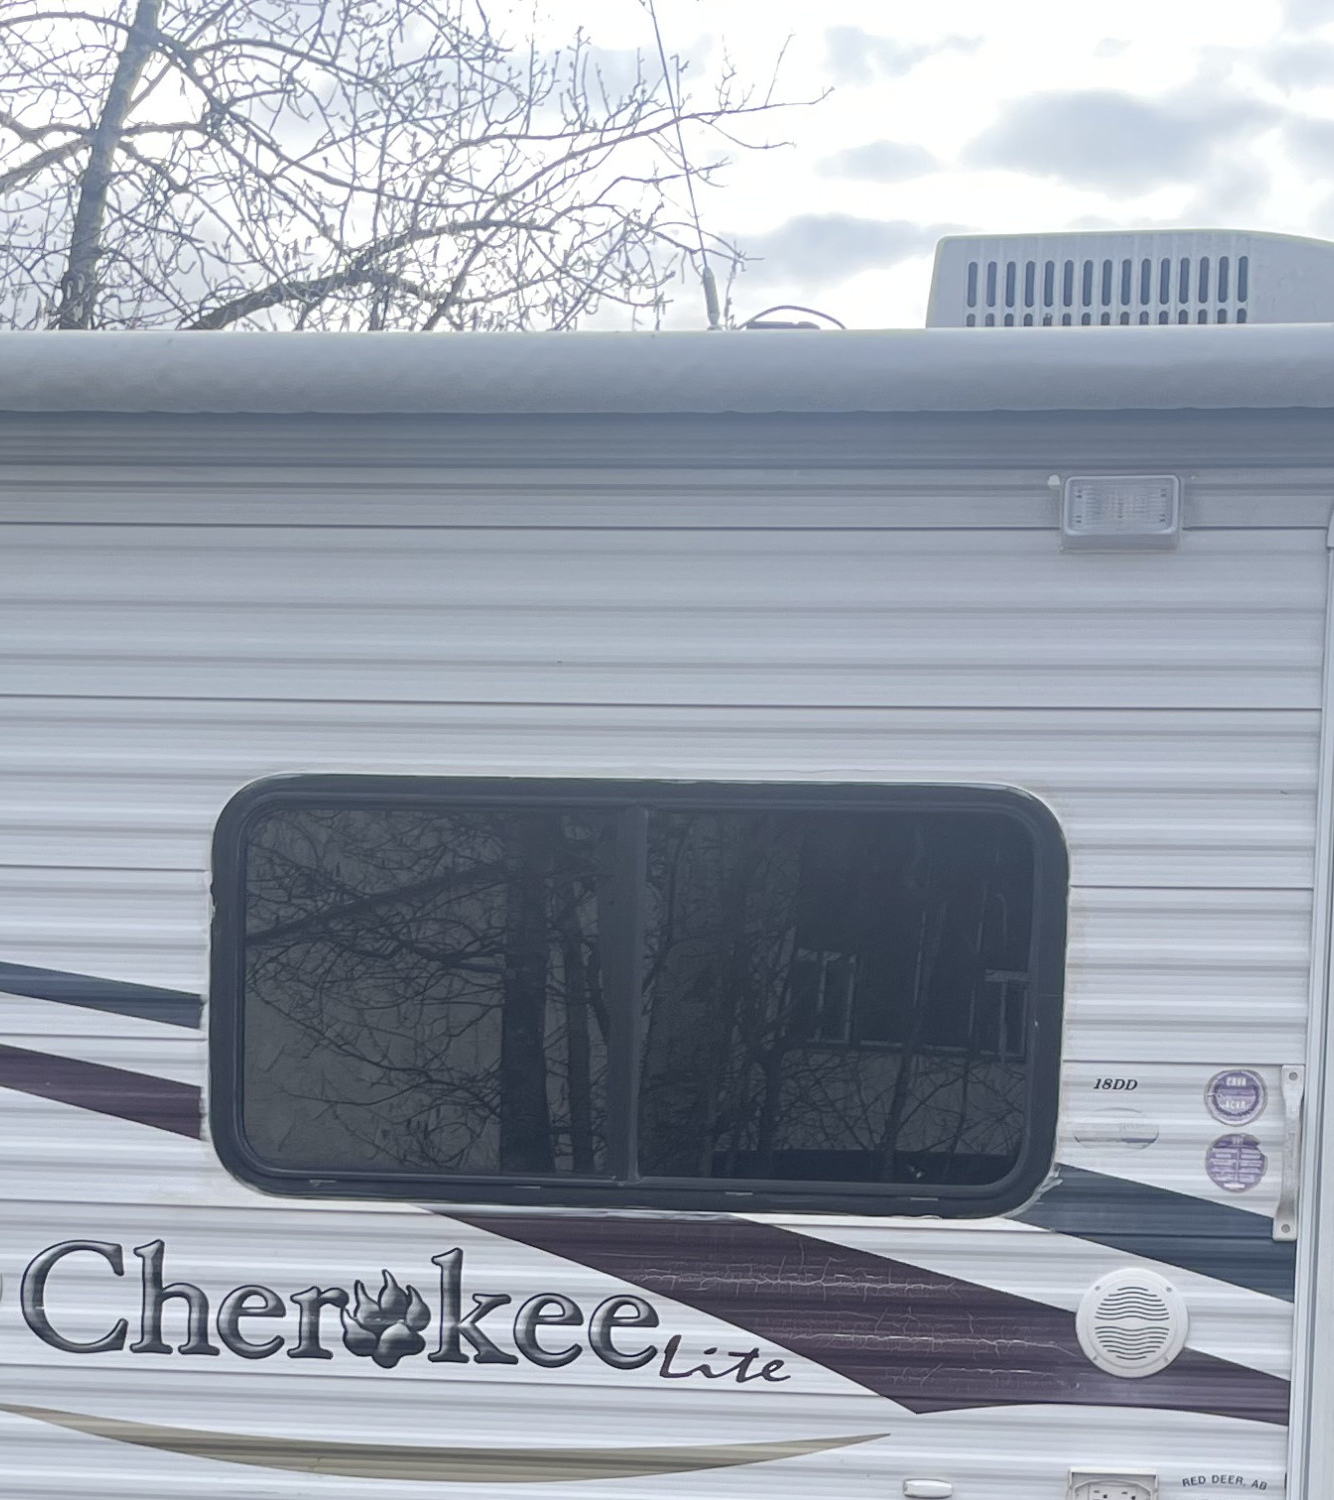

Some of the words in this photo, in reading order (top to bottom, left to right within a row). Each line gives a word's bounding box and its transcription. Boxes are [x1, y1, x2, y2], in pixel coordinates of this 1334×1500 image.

[1093, 1078, 1138, 1091] 18DD
[659, 1334, 791, 1383] Lite
[1182, 1475, 1206, 1488] RED
[1251, 1479, 1268, 1491] AB
